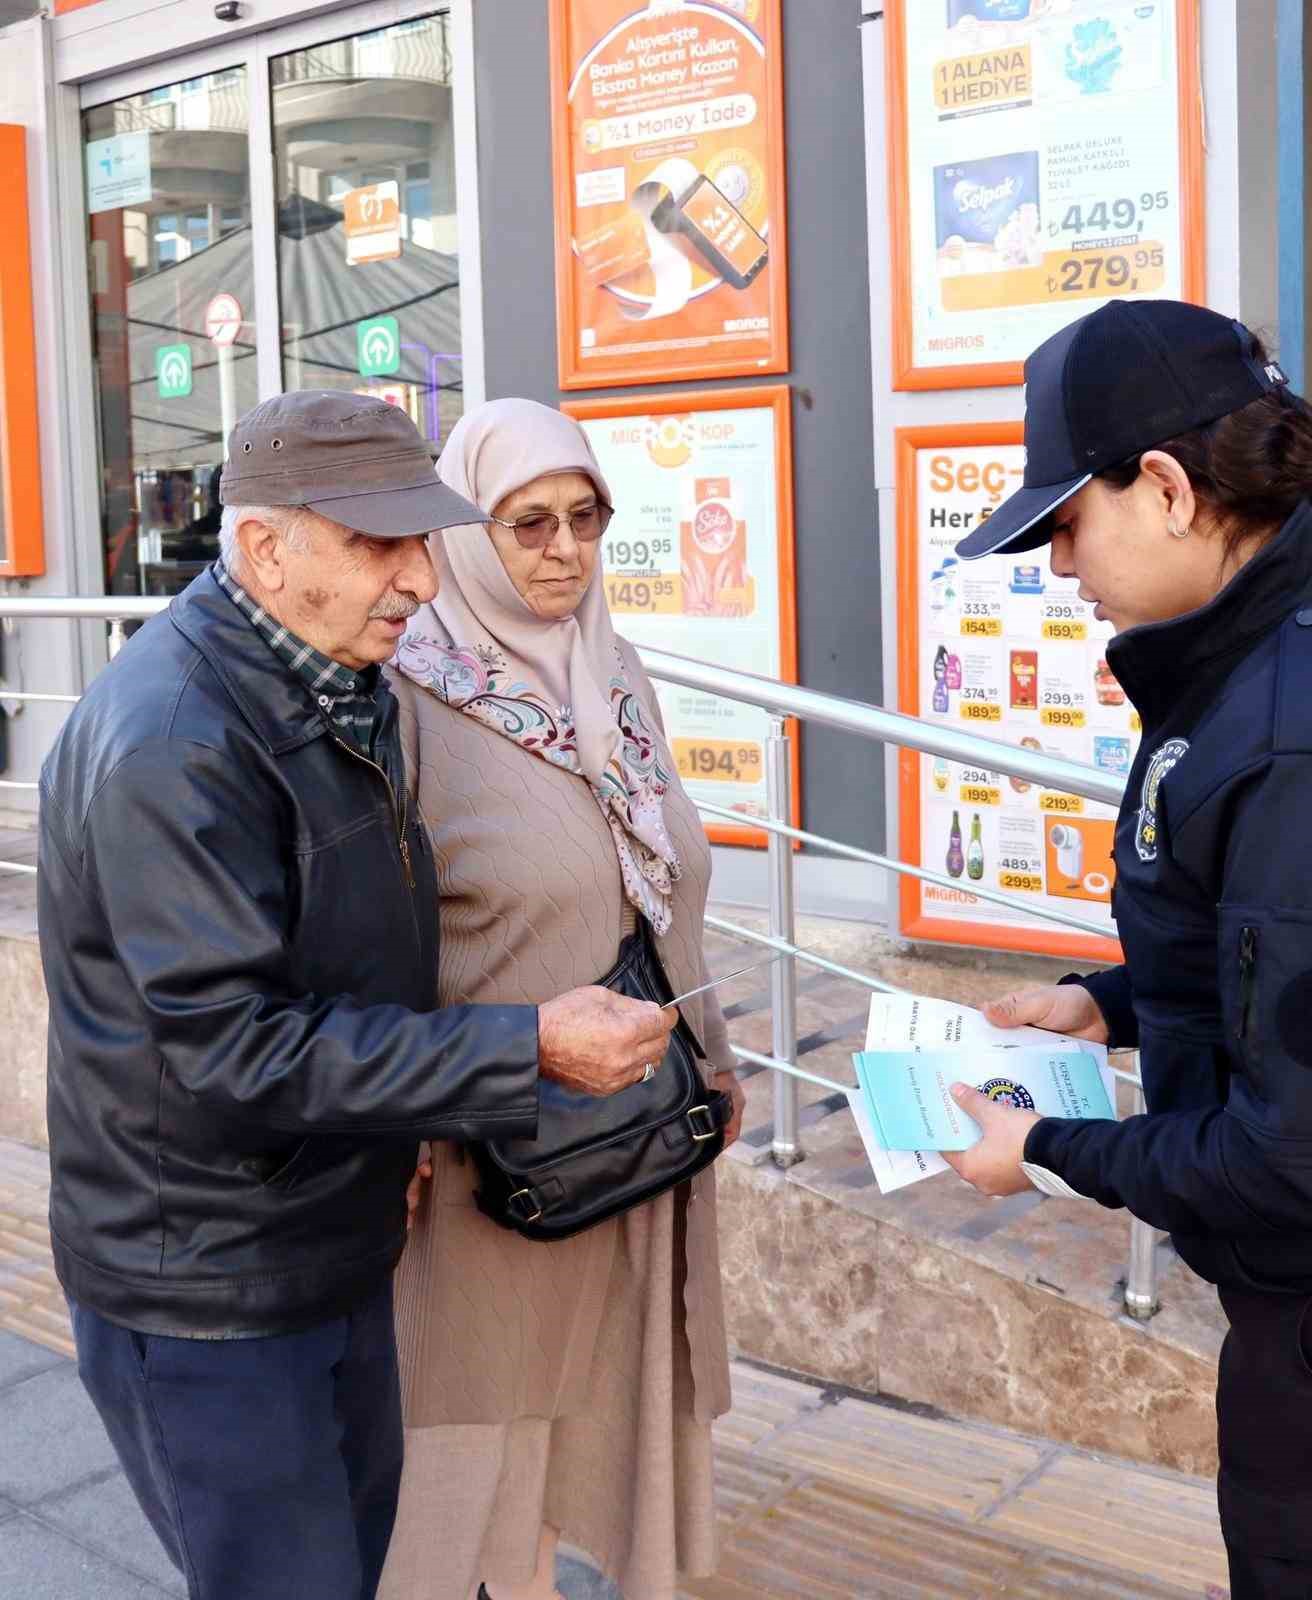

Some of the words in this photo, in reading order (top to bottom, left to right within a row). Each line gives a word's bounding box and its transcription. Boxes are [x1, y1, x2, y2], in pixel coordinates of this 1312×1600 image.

[590, 60, 634, 79] Banka
[940, 66, 948, 82] 1
[953, 51, 1025, 81] ALANA
[640, 68, 687, 88] Money
[941, 89, 949, 105] 1
[953, 74, 1027, 103] HEDİYE
[638, 115, 695, 136] Money
[929, 508, 973, 528] Her
